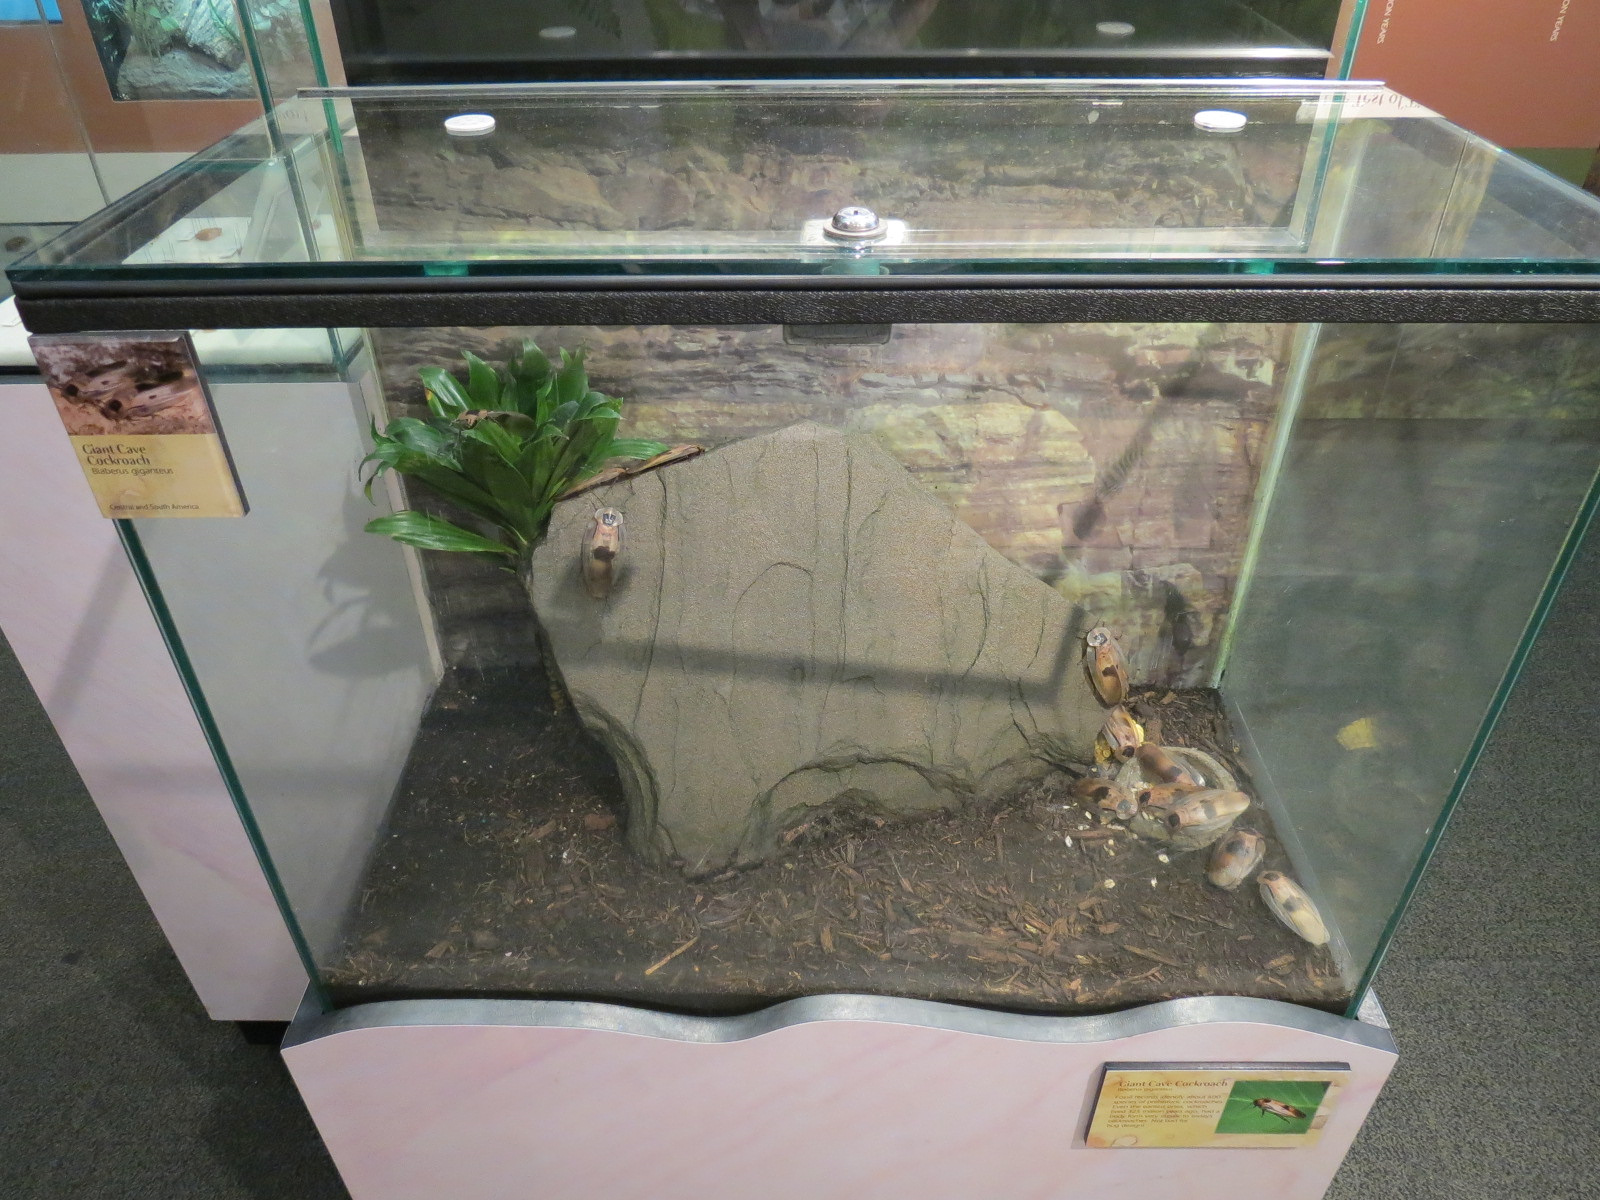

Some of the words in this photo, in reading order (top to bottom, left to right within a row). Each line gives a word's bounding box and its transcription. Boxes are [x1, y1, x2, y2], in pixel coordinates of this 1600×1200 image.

[1377, 18, 1390, 44] YEARS
[1550, 15, 1565, 41] YEARS
[82, 443, 114, 455] Giant
[116, 443, 146, 455] Cave
[86, 454, 151, 466] Cockroach
[131, 467, 174, 476] giganteus
[109, 503, 134, 511] Central
[135, 503, 149, 511] and
[149, 503, 171, 511] South
[171, 503, 200, 511] America
[1175, 1079, 1228, 1087] Cockroach
